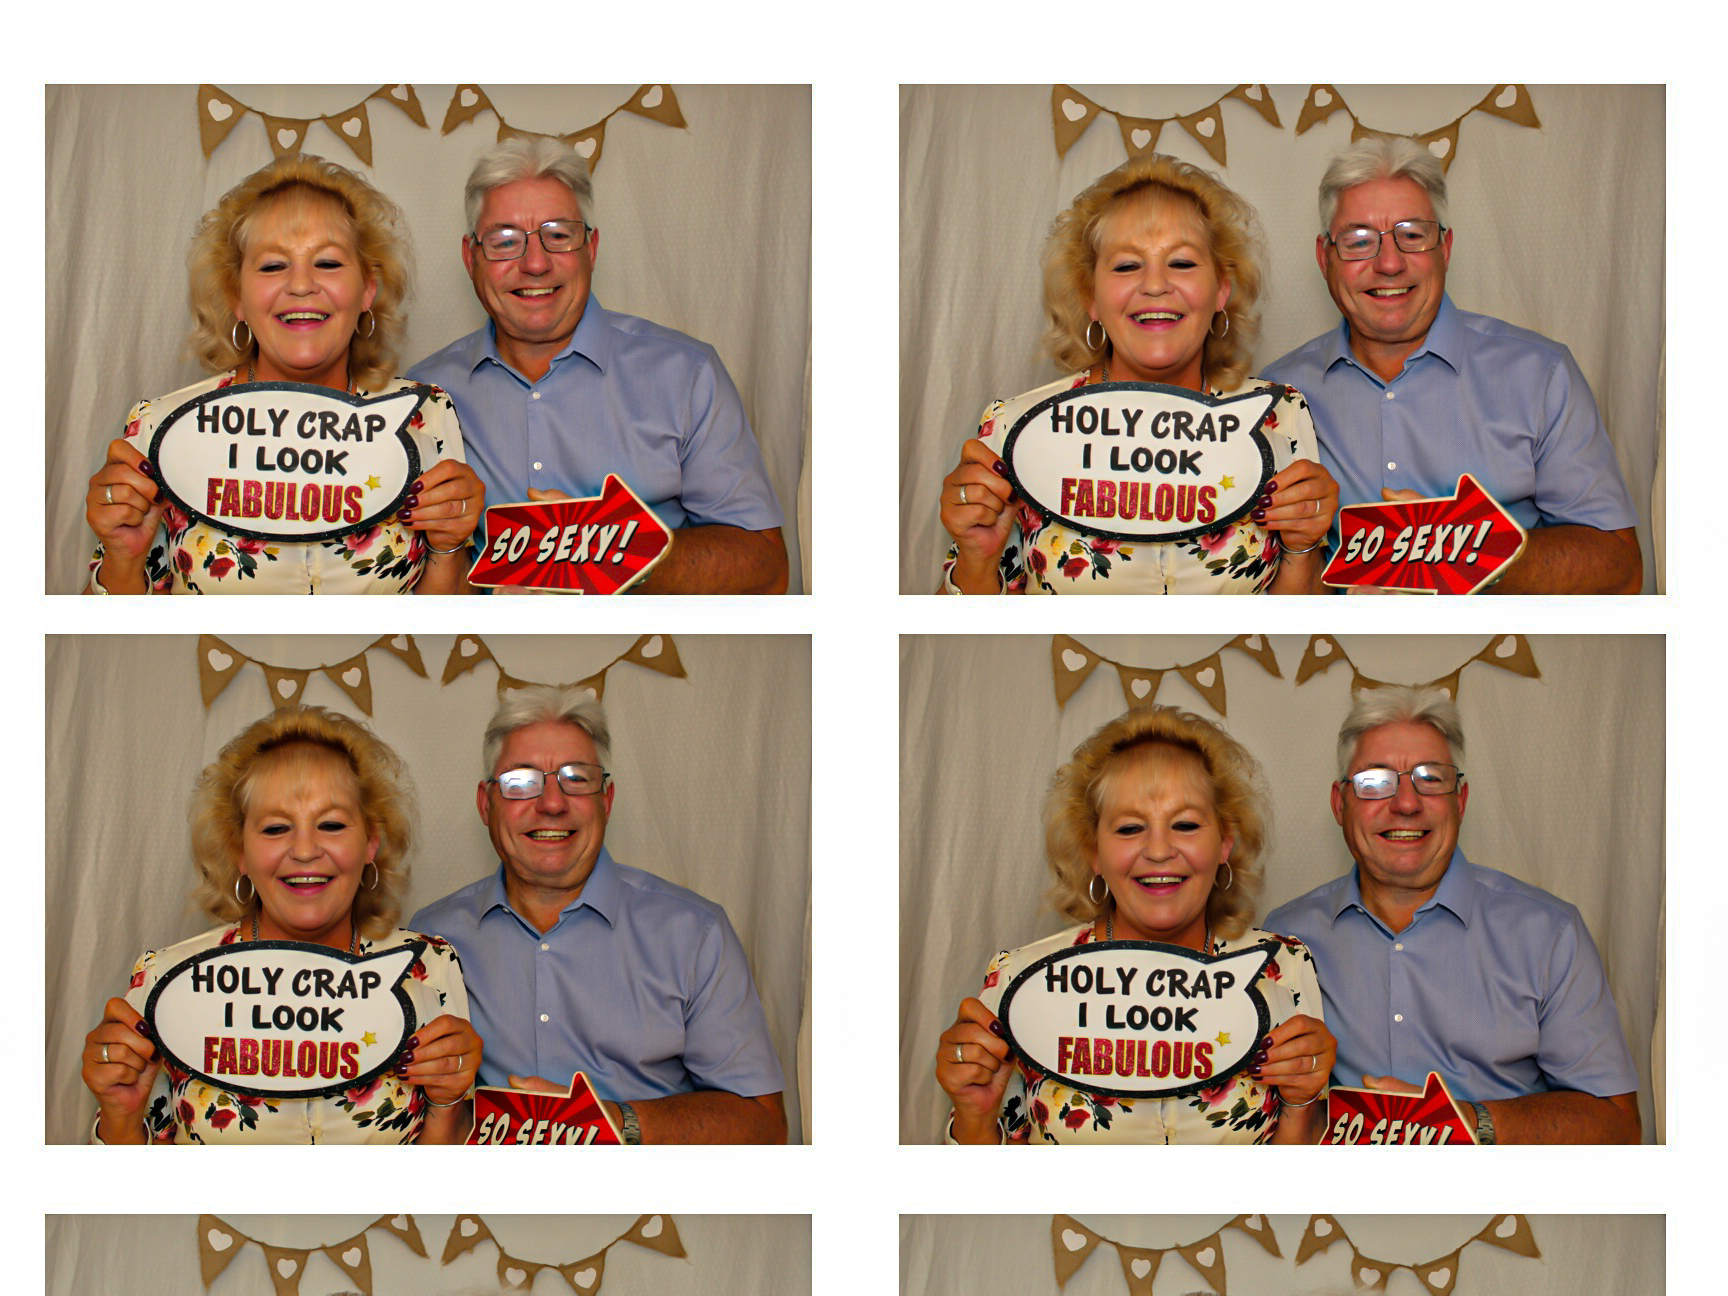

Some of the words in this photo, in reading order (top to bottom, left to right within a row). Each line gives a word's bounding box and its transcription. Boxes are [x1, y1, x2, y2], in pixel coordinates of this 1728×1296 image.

[196, 404, 290, 438] HOLY
[297, 410, 387, 443] CRAP
[1050, 404, 1144, 438] HOLY
[1151, 410, 1241, 443] CRAP
[228, 443, 238, 469] I
[256, 445, 350, 476] LOOK
[1082, 443, 1092, 469] I
[1110, 445, 1204, 476] LOOK
[206, 477, 365, 524] FABULOUS
[1060, 477, 1219, 524] FABULOUS
[490, 525, 531, 564] SO
[536, 519, 639, 565] SEXY!
[1344, 525, 1385, 564] SO
[1390, 519, 1493, 565] SEXY!
[191, 964, 284, 996] HOLY
[291, 968, 382, 1000] CRAP
[1045, 964, 1138, 996] HOLY
[1145, 968, 1236, 1000] CRAP
[224, 1001, 234, 1028] I
[251, 1004, 345, 1034] LOOK
[1078, 1001, 1088, 1028] I
[1105, 1004, 1199, 1034] LOOK
[203, 1036, 361, 1080] FABULOUS
[1057, 1036, 1215, 1080] FABULOUS
[476, 1112, 512, 1145] SO
[1330, 1112, 1366, 1145] SO
